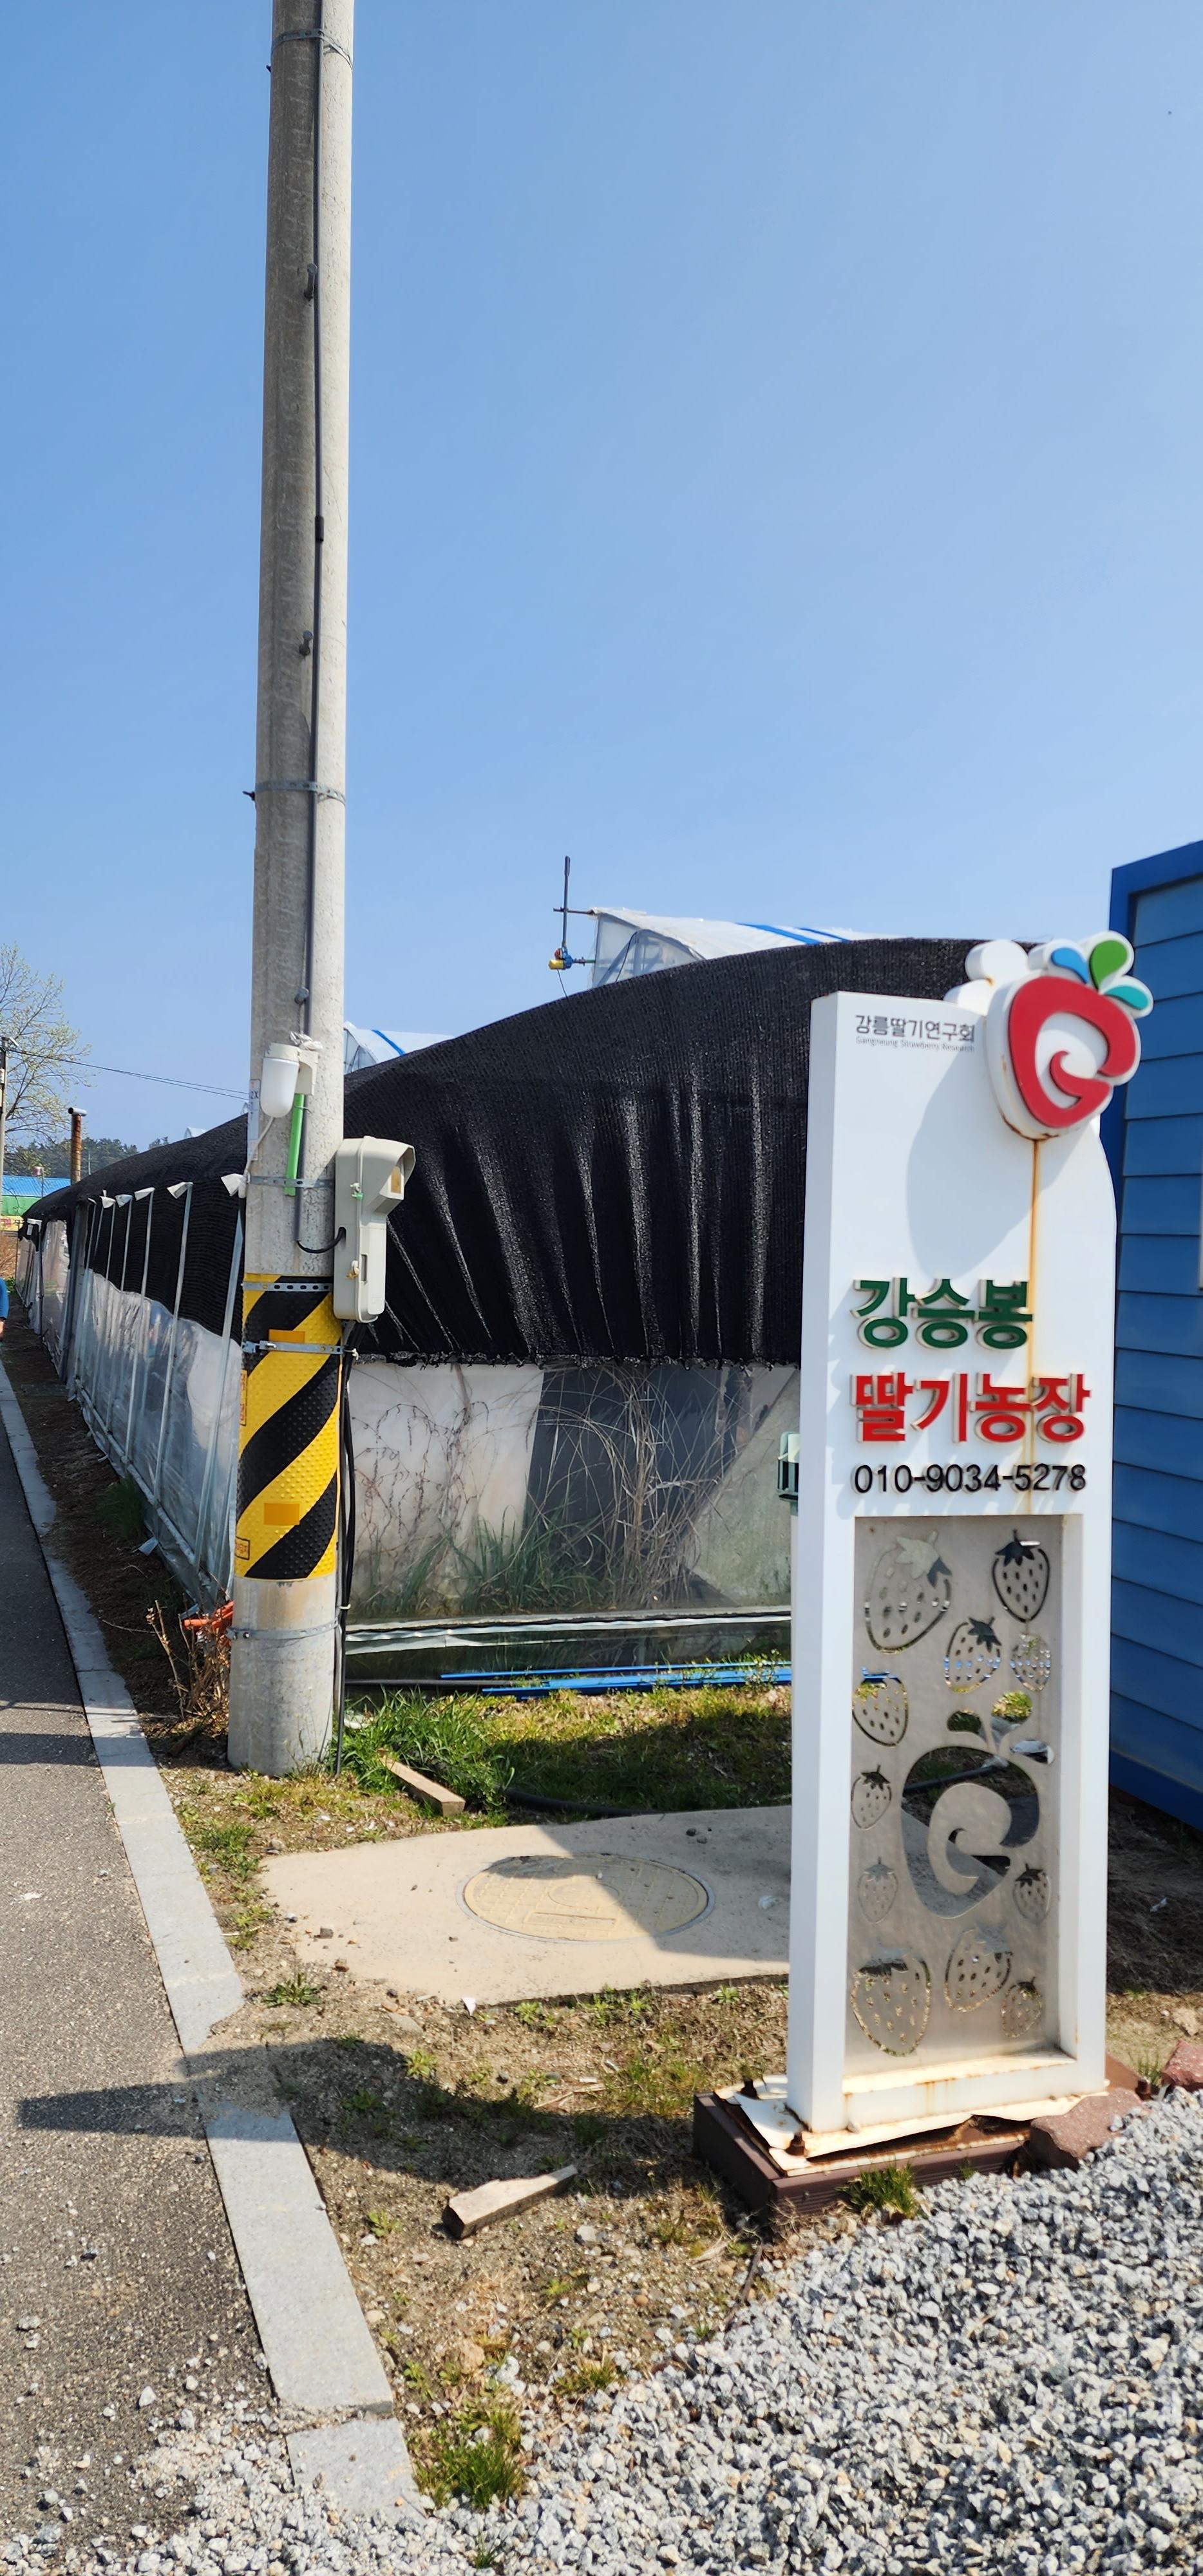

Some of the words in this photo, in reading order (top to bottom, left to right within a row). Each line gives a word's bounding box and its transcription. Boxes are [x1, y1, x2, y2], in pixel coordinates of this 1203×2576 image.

[855, 1014, 976, 1043] 강릉딸기연구회
[901, 1039, 939, 1051] Strawberry
[942, 1042, 975, 1053] Research
[851, 1277, 1034, 1350] 강승봉
[851, 1372, 1092, 1443] 딸기농장
[853, 1463, 1087, 1493] 010-9034-5278
